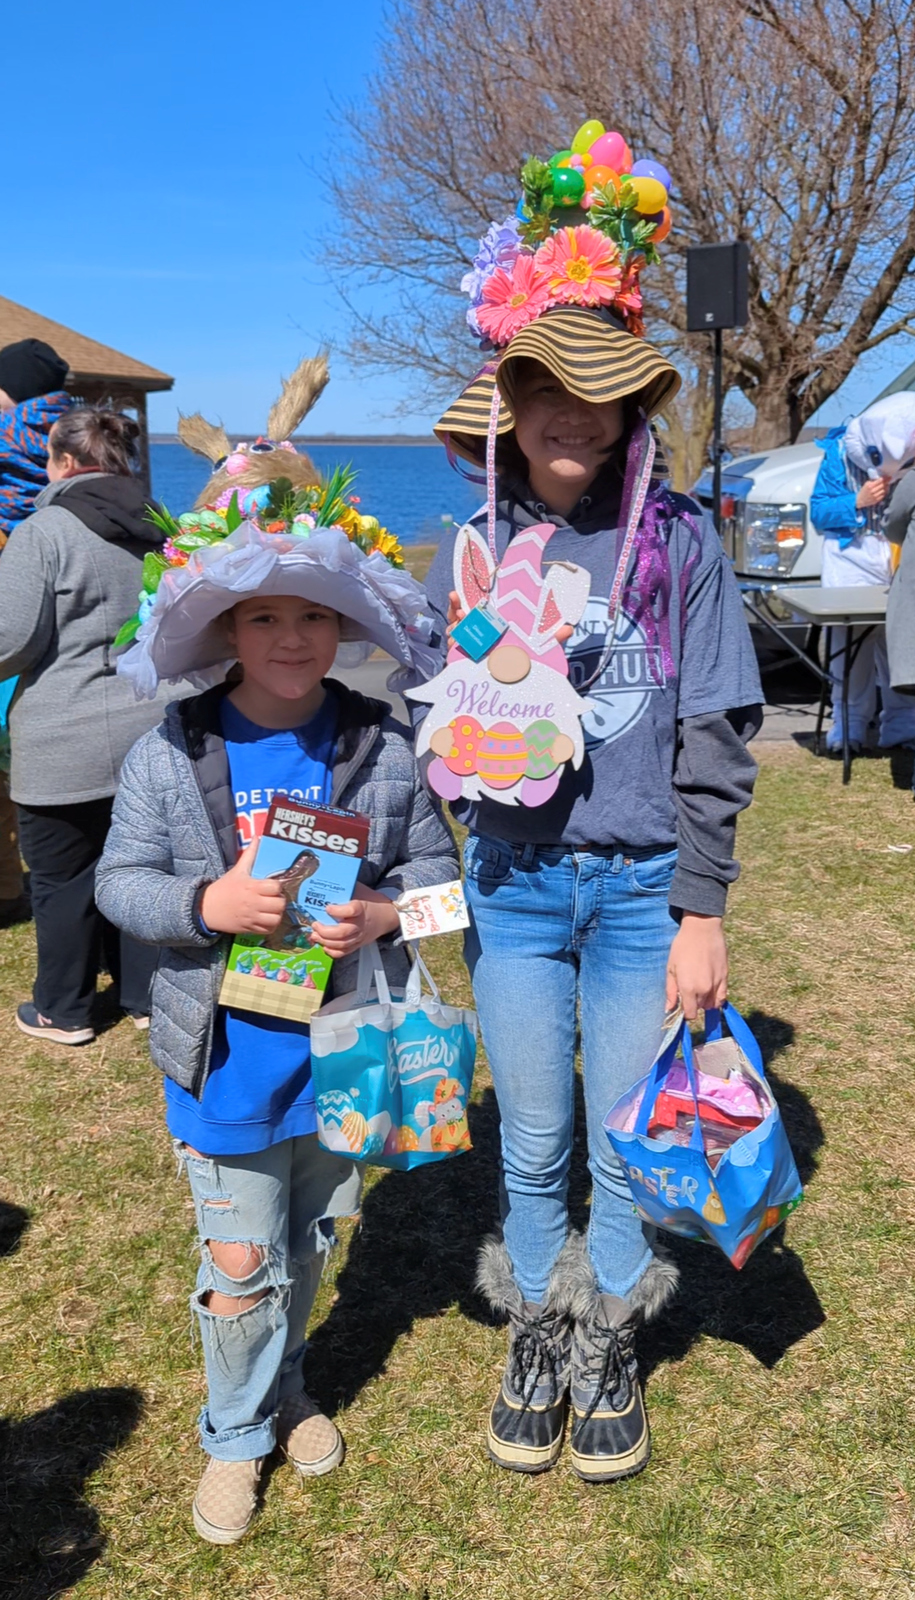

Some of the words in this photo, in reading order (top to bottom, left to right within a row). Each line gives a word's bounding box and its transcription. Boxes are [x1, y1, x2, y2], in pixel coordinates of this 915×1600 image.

[575, 620, 614, 637] NTY
[599, 653, 662, 685] HUB
[446, 679, 555, 718] Welcome
[274, 807, 316, 827] HERSHEY'S
[270, 819, 359, 854] KISSES
[304, 896, 338, 909] KISS
[387, 1034, 454, 1093] Easter
